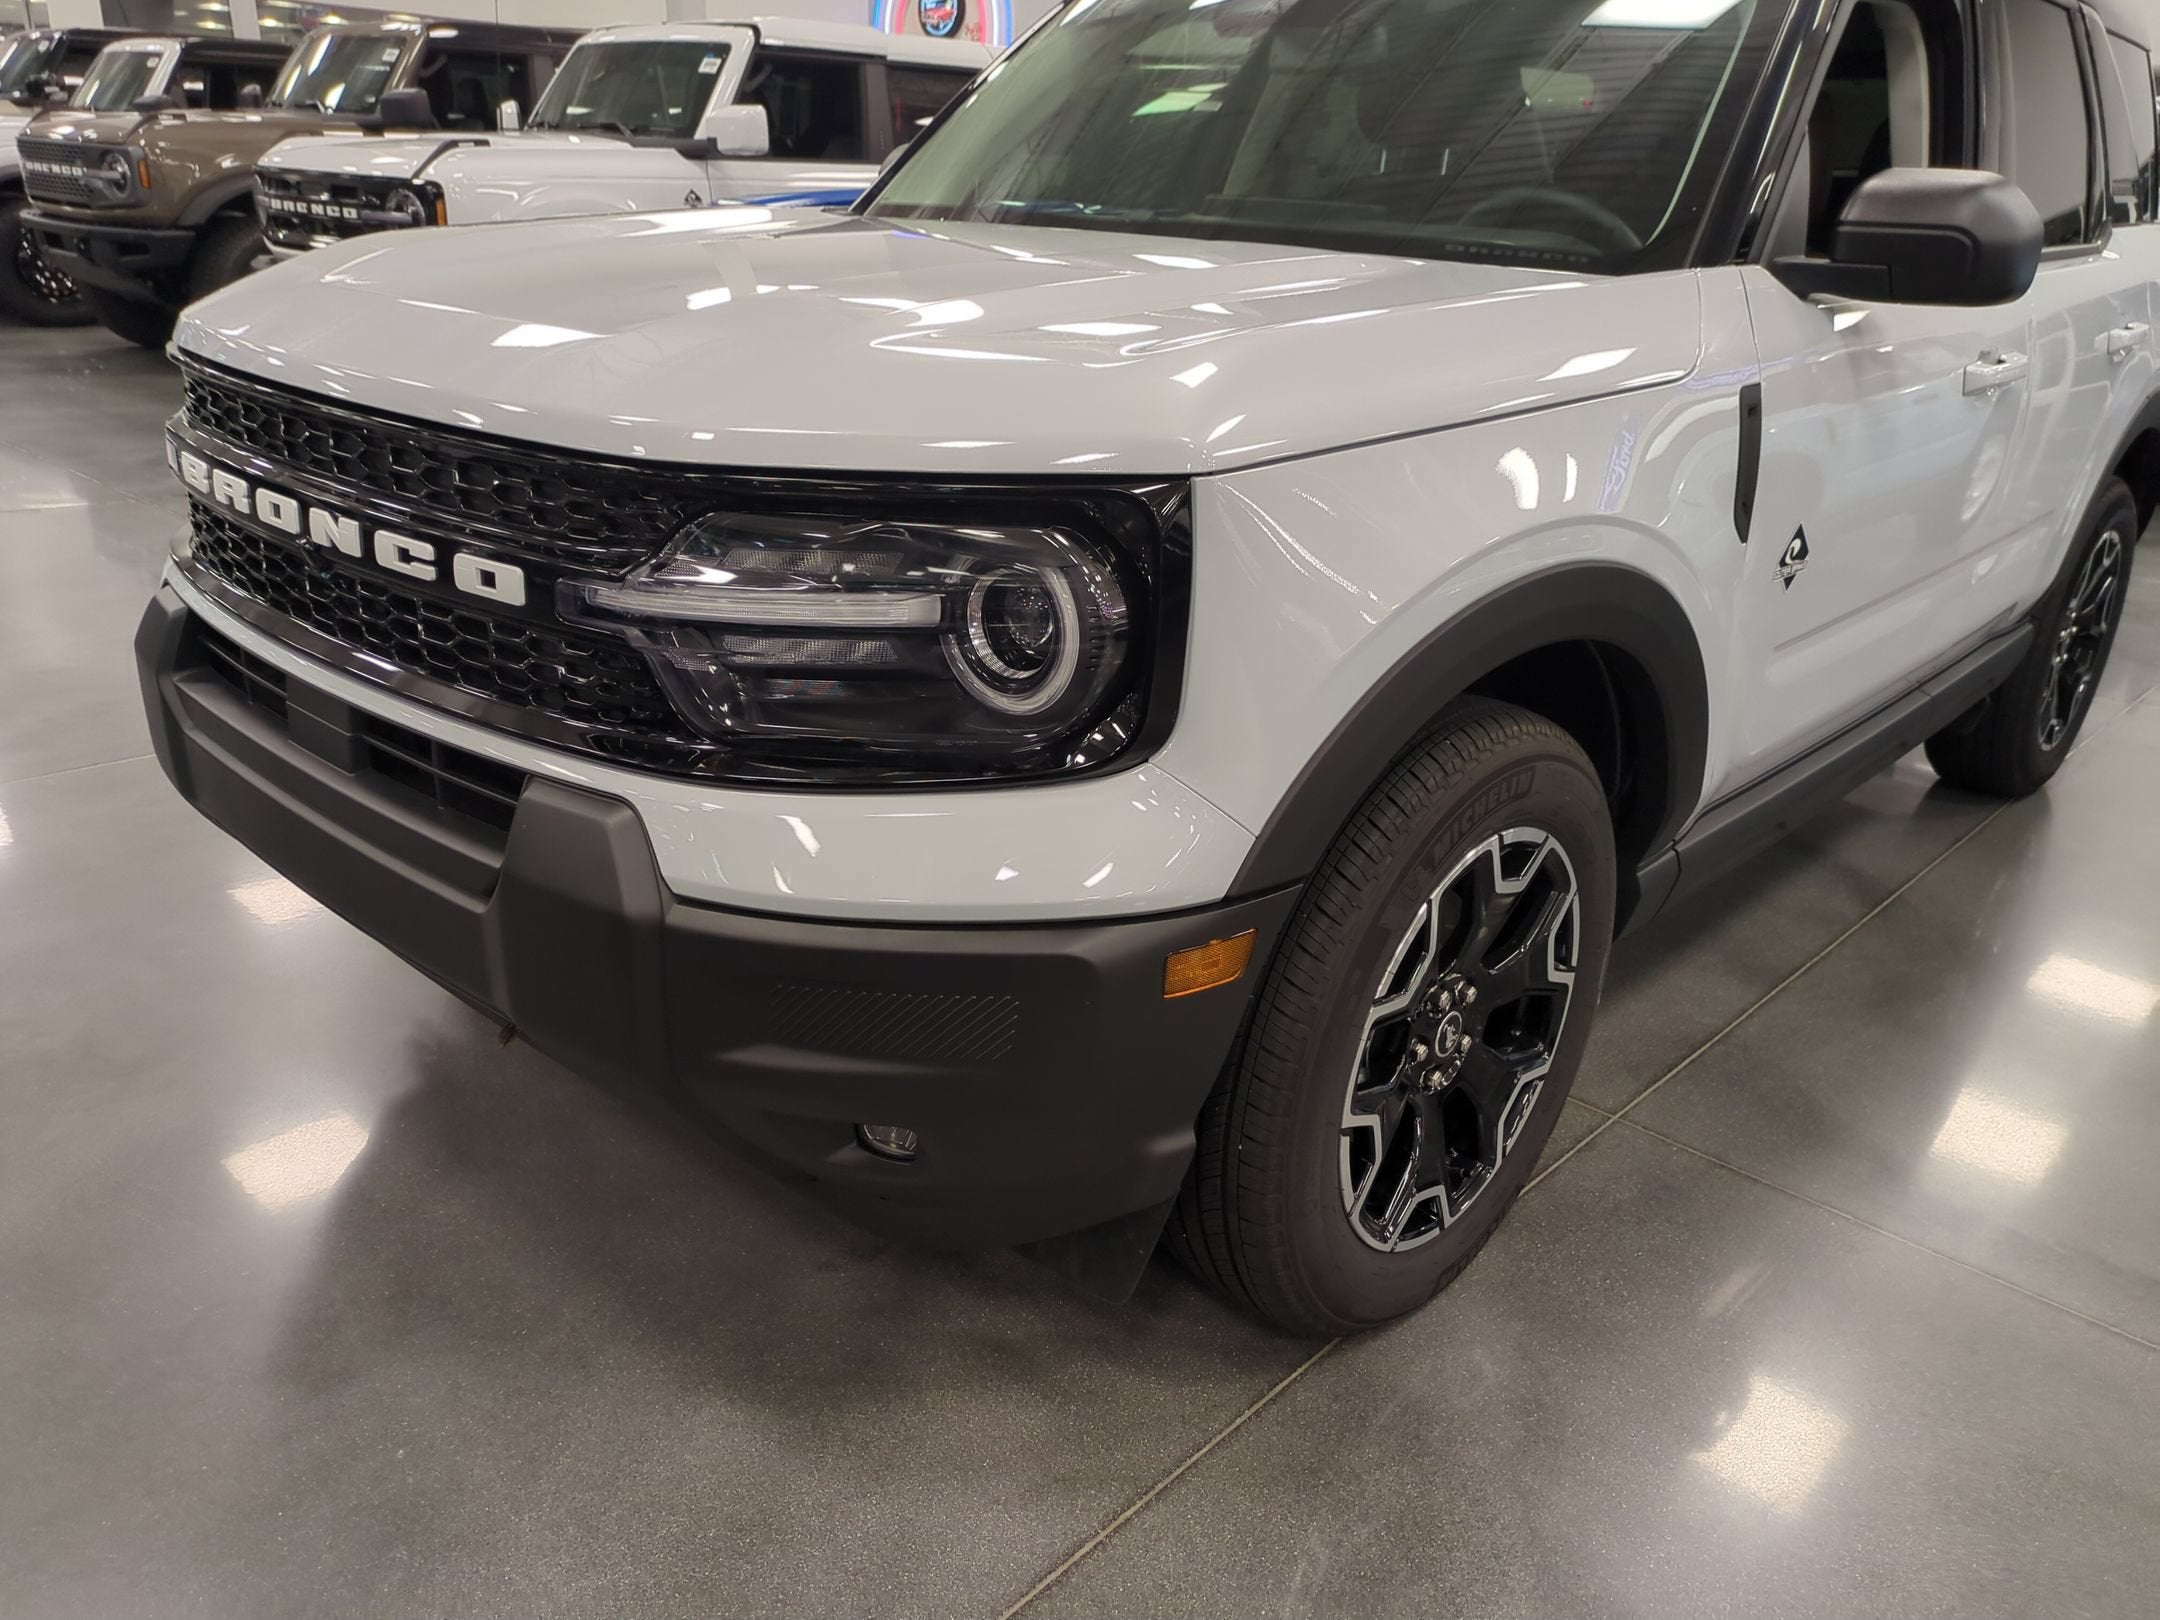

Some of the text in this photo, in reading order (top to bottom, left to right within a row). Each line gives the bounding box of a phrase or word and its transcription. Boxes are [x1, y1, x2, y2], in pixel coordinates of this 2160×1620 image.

[270, 198, 359, 219] BRONCO
[181, 450, 527, 607] BRONCO
[1431, 771, 1533, 865] MICHELIN
